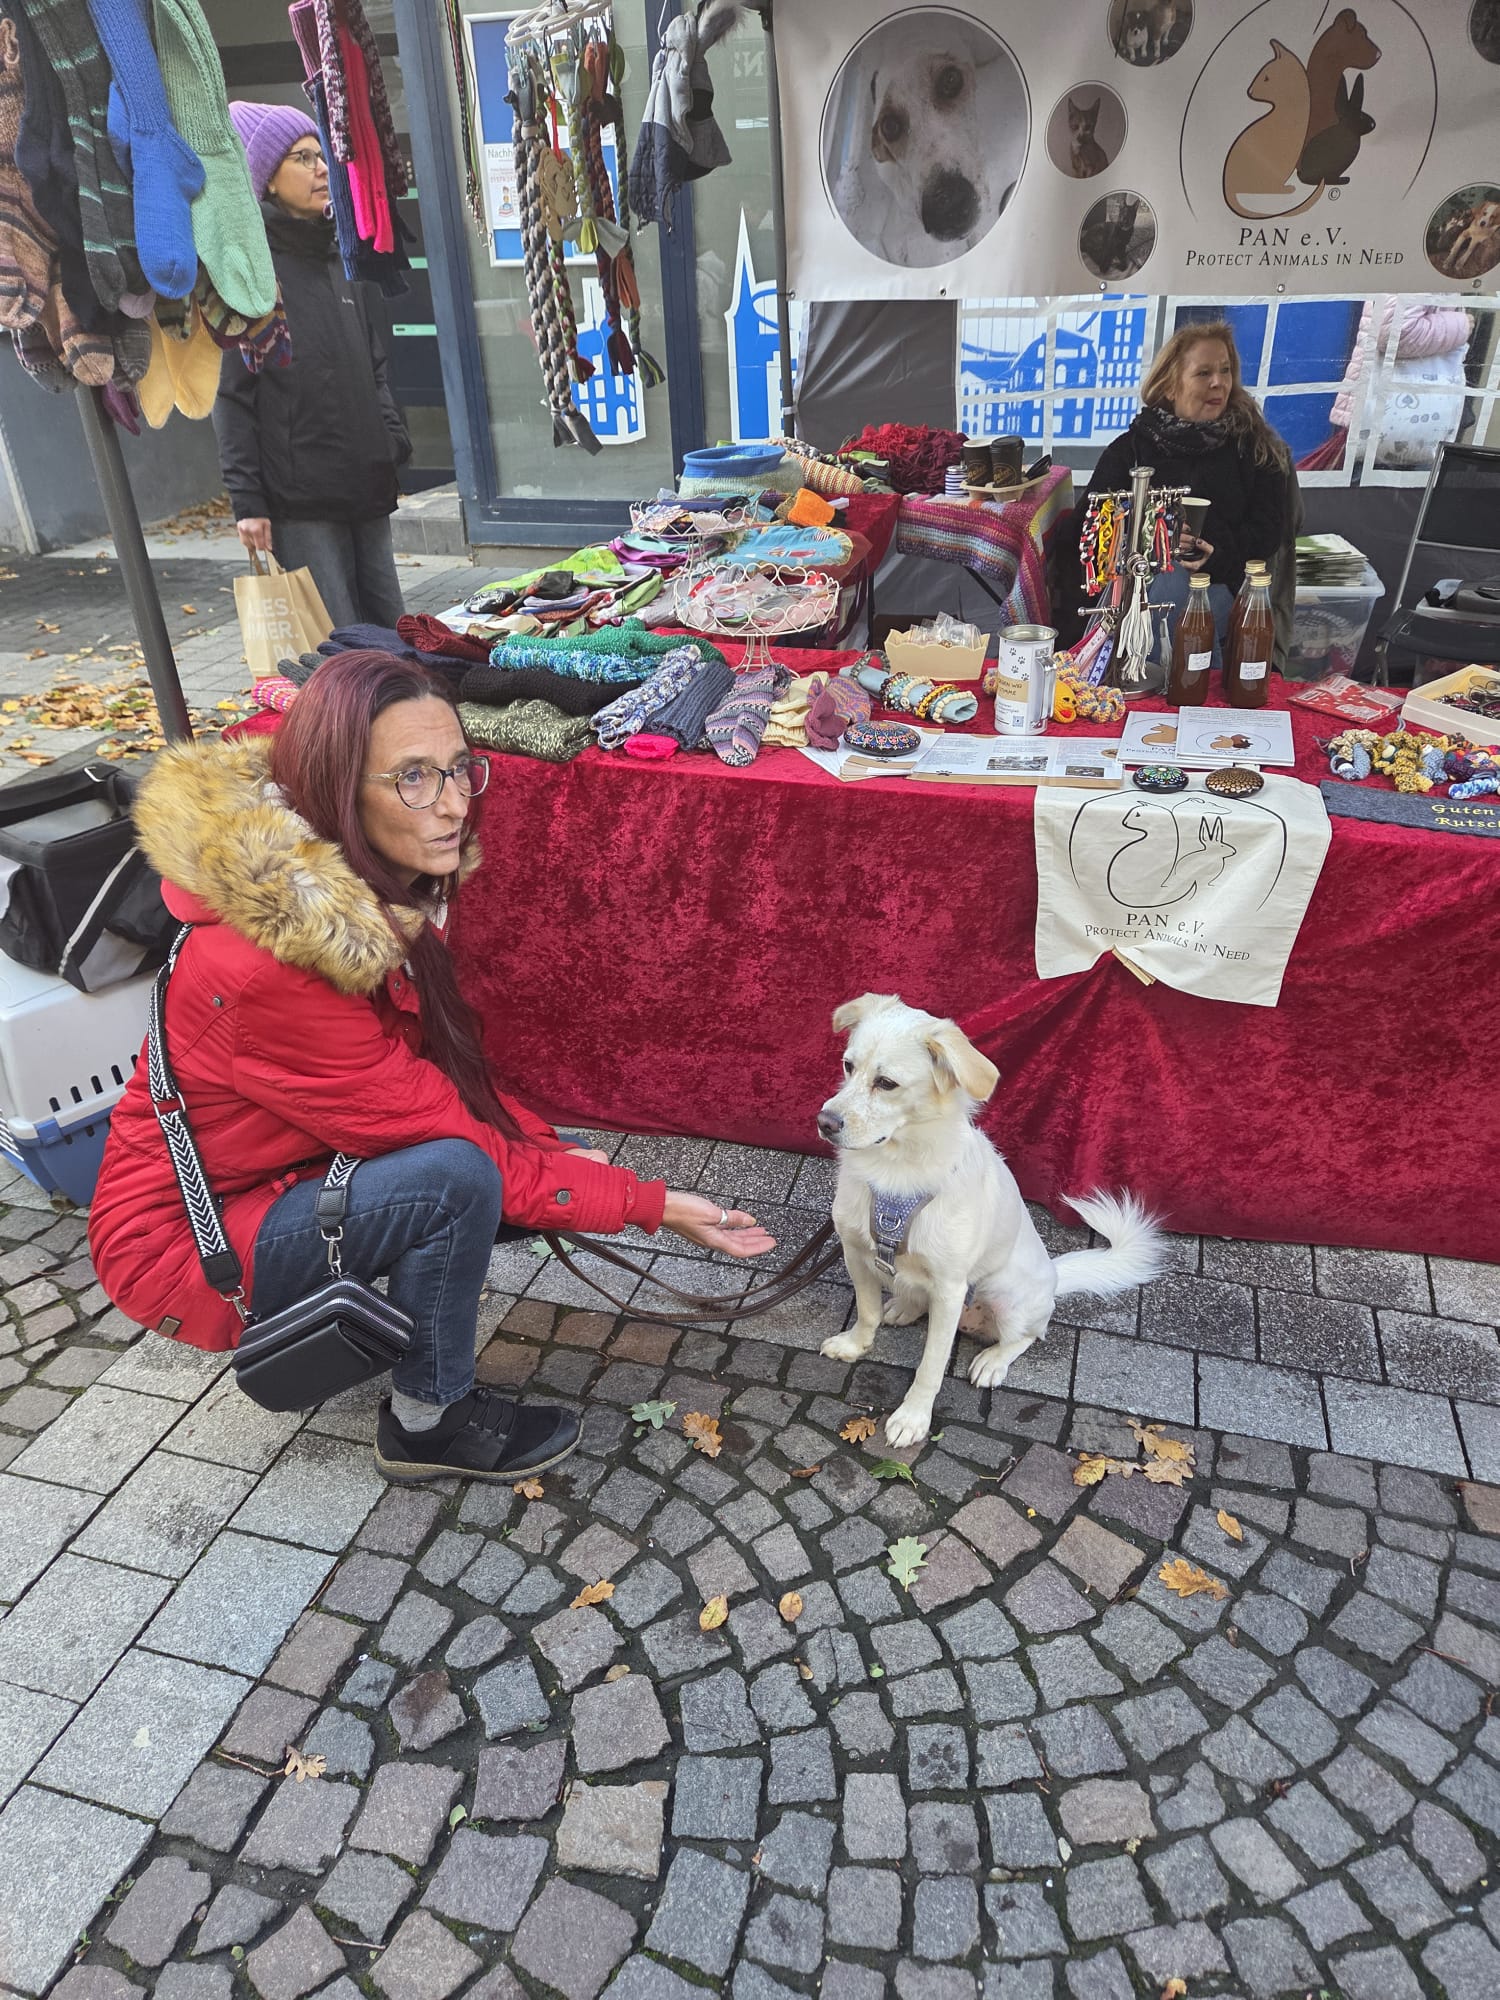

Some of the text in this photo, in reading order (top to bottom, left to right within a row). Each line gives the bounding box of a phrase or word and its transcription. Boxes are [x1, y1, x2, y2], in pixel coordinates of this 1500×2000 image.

[1238, 227, 1290, 246] PAN
[1185, 248, 1404, 266] PROTECT ANIMALS IN NEED
[1431, 804, 1495, 816] Guten
[1126, 913, 1170, 928] PAN
[1085, 924, 1251, 961] PROTECT ANIMALS IN NEED
